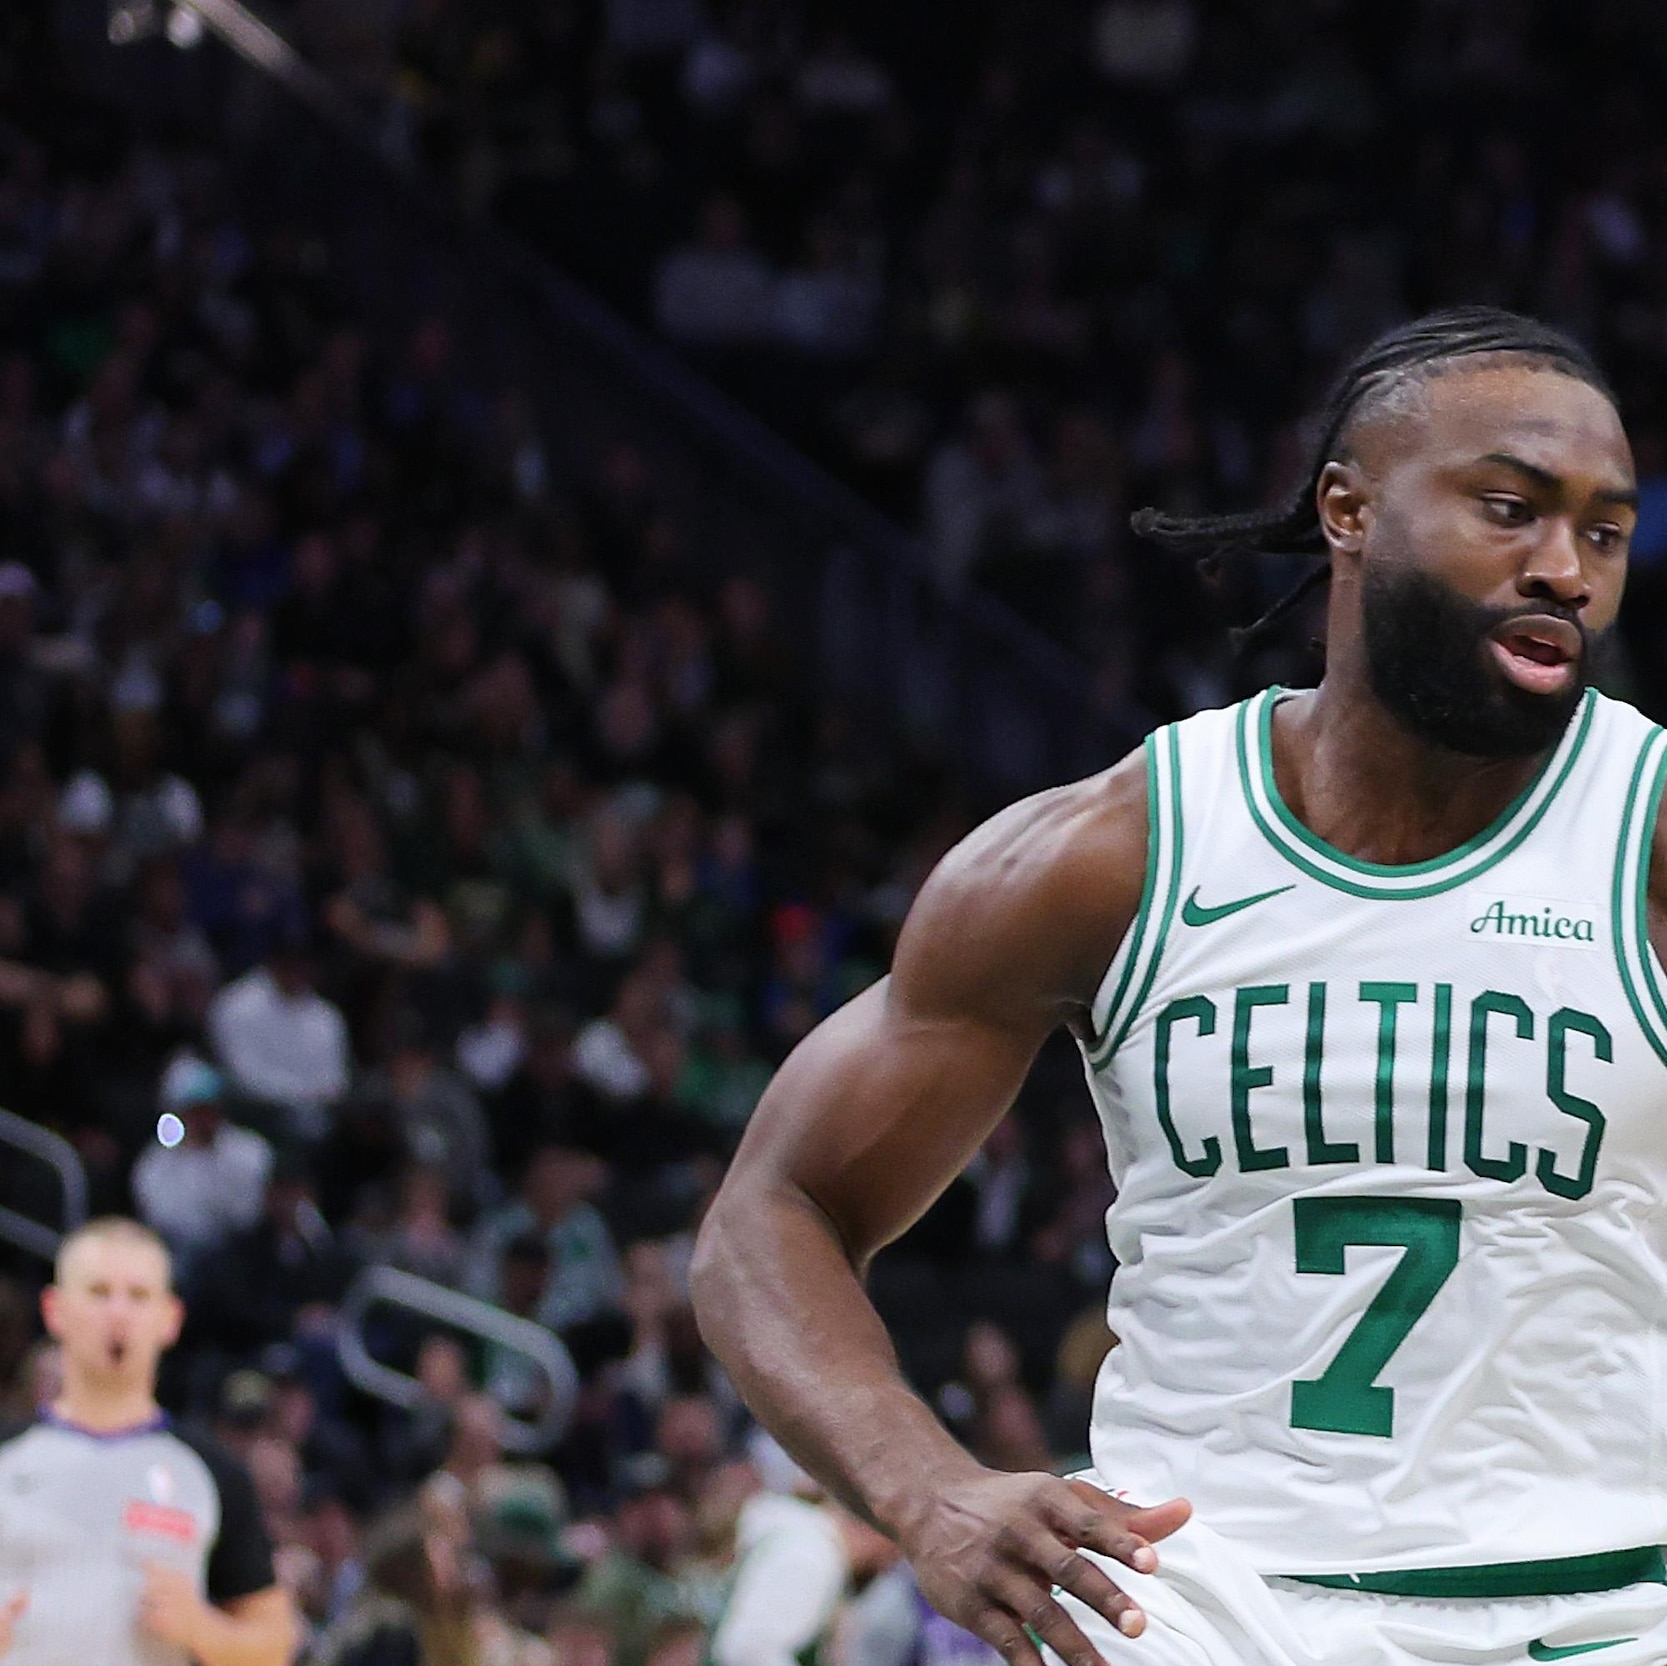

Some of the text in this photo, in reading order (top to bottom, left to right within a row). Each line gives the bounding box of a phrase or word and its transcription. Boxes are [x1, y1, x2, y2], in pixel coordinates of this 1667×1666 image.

[1470, 900, 1595, 942] Amica
[1154, 981, 1614, 1201] CELTICS
[1290, 1194, 1464, 1439] 7
